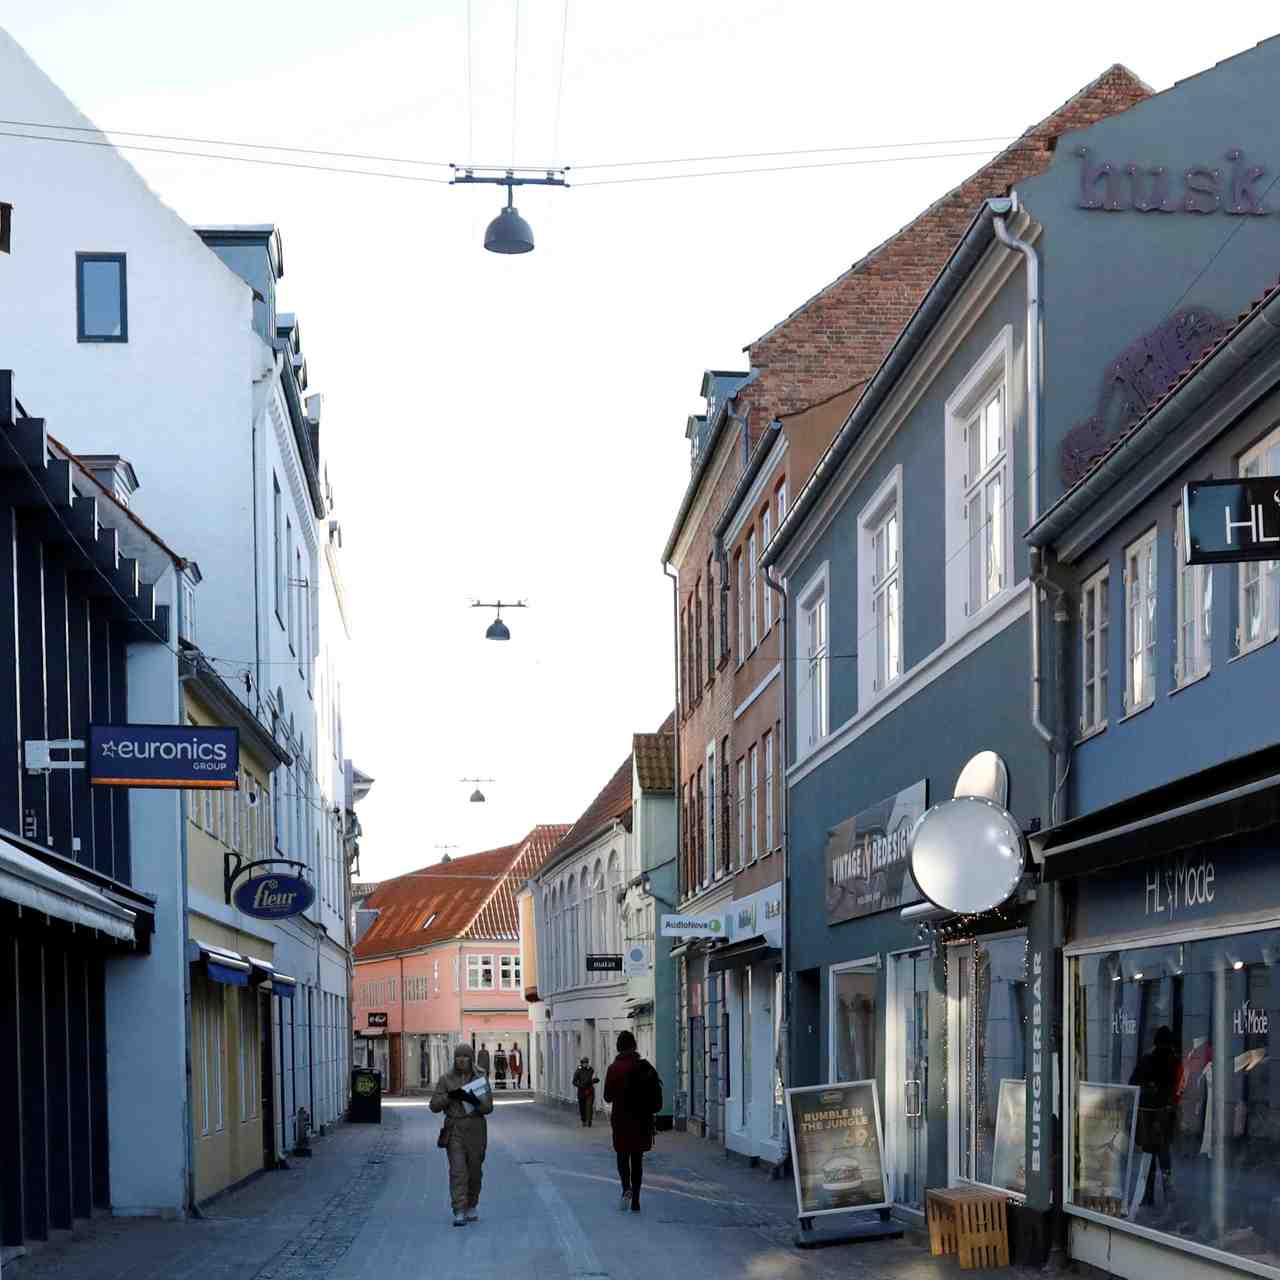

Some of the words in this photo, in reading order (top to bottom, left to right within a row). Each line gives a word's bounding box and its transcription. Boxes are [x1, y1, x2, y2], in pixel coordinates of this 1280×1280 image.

[1225, 504, 1280, 544] HL
[118, 737, 227, 760] euronics
[192, 762, 227, 770] GROUP
[832, 847, 862, 886] VINTAGE
[253, 879, 296, 908] fleur
[1145, 871, 1164, 914] HL
[1174, 857, 1215, 907] Mode
[665, 919, 708, 929] AudioNova
[1233, 1008, 1243, 1034] HL
[1248, 1008, 1268, 1034] Mode
[1032, 952, 1042, 1171] BURGERBAR
